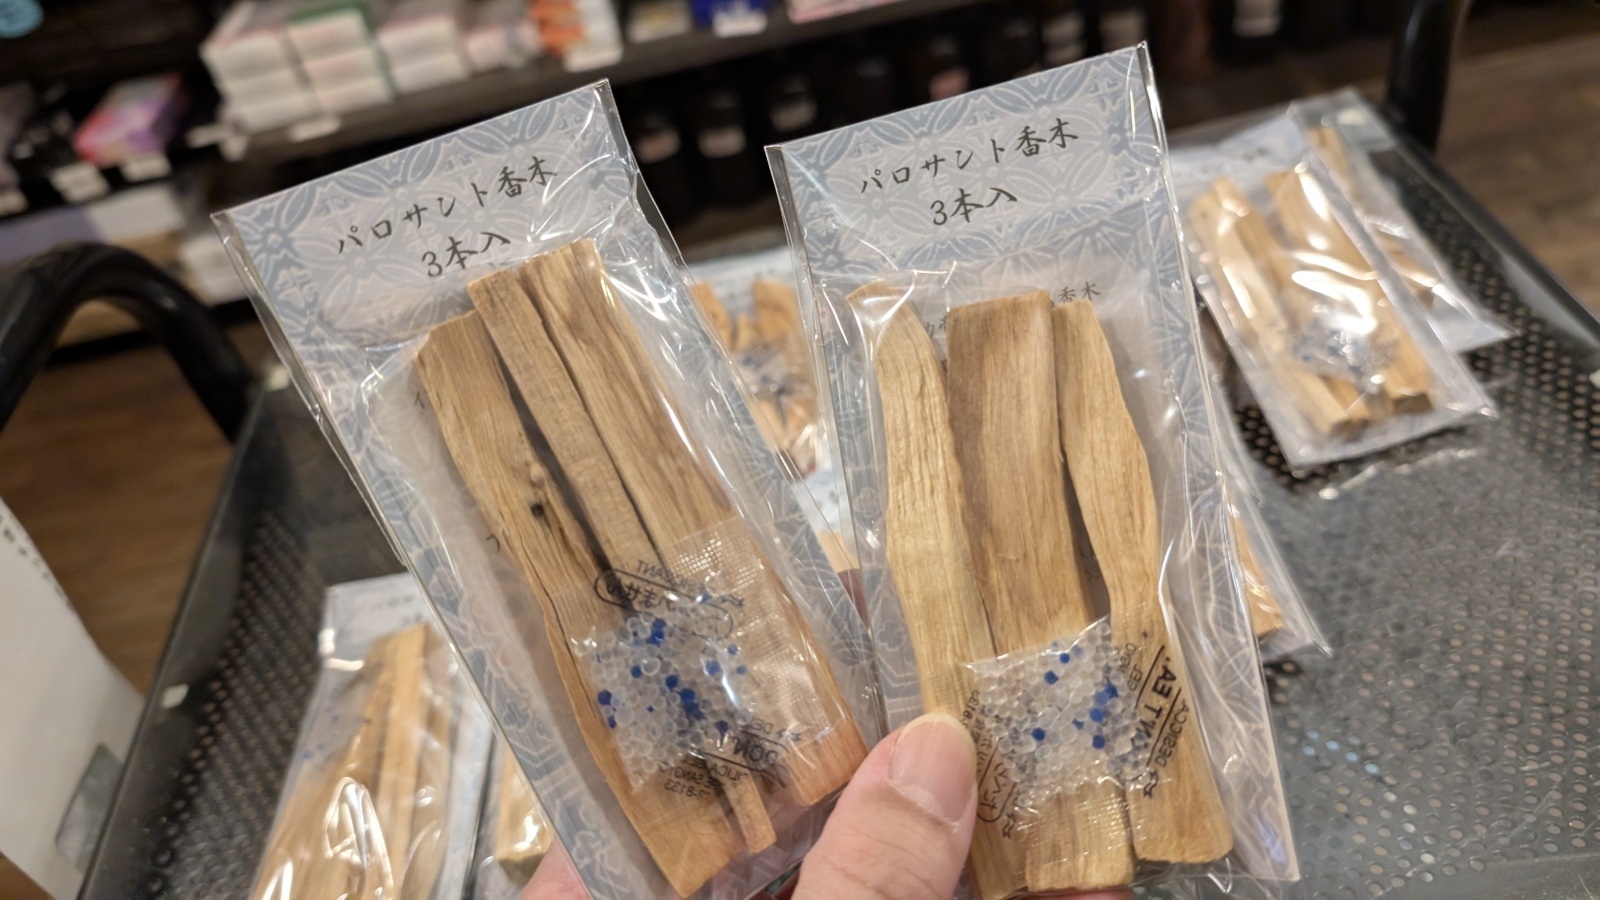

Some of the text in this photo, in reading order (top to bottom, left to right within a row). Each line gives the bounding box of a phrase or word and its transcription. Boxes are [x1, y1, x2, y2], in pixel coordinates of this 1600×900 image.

[860, 117, 1079, 194] パロサント香木
[337, 156, 557, 255] パロサント香木
[929, 187, 1018, 226] 3本入
[421, 231, 511, 278] 3本入
